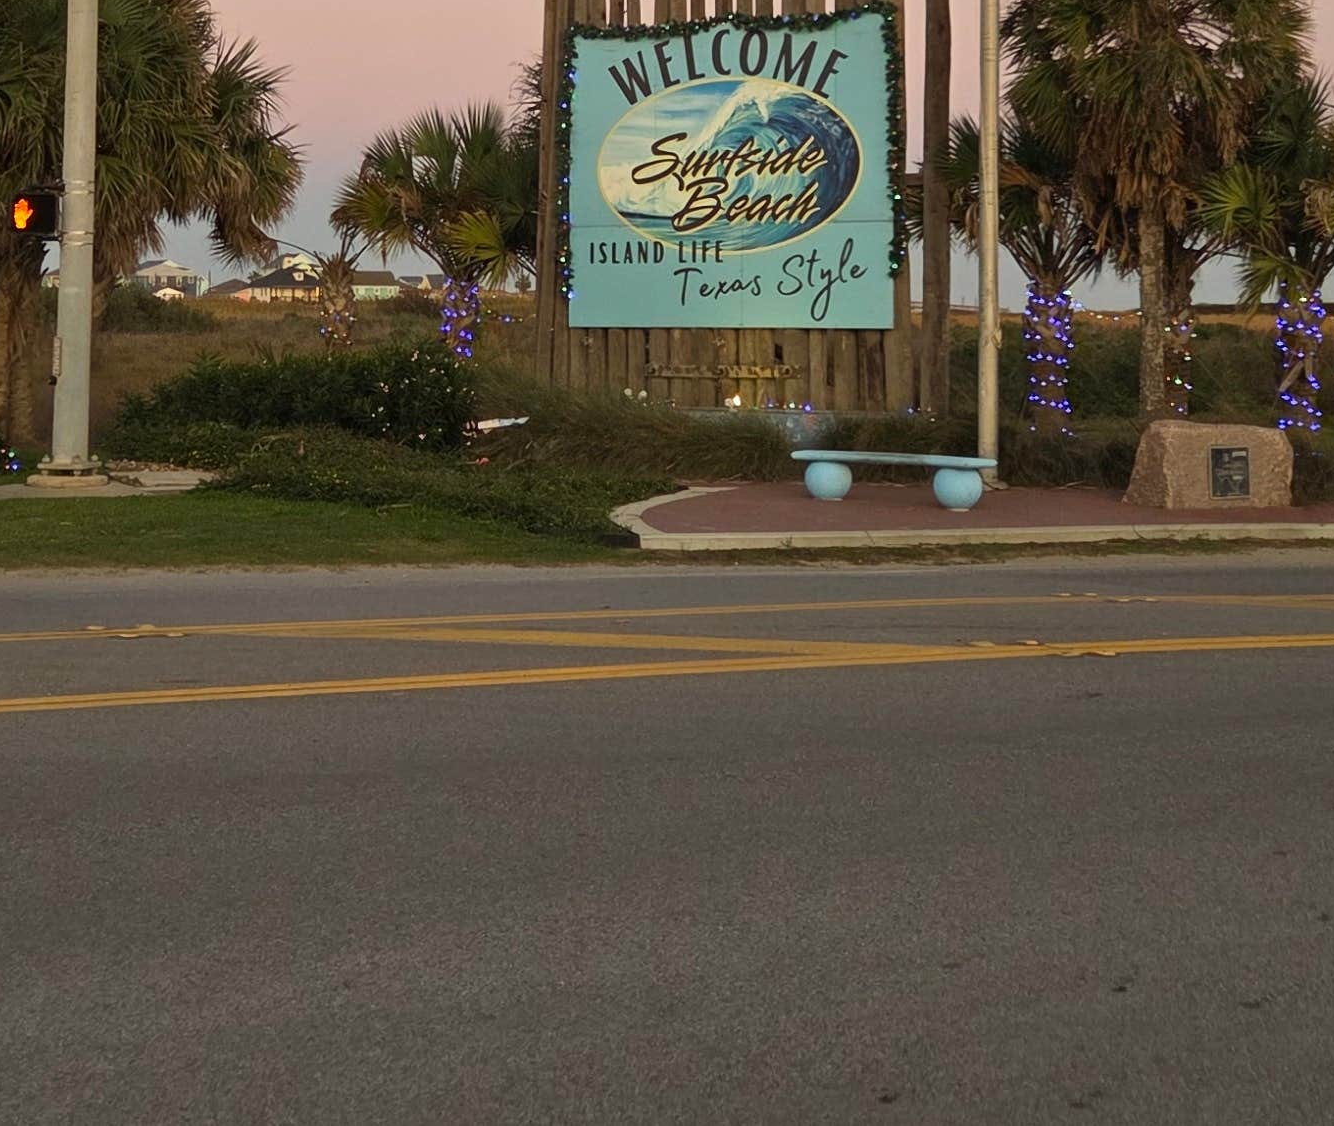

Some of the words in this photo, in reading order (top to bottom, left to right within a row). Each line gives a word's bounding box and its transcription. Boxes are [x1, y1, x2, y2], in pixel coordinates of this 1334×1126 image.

[608, 27, 849, 106] WELCOME
[632, 132, 828, 186] Surfside
[671, 174, 821, 233] Beach
[589, 241, 665, 265] ISLAND
[678, 240, 725, 264] LIFE
[673, 267, 762, 306] Texas
[777, 237, 868, 322] Style
